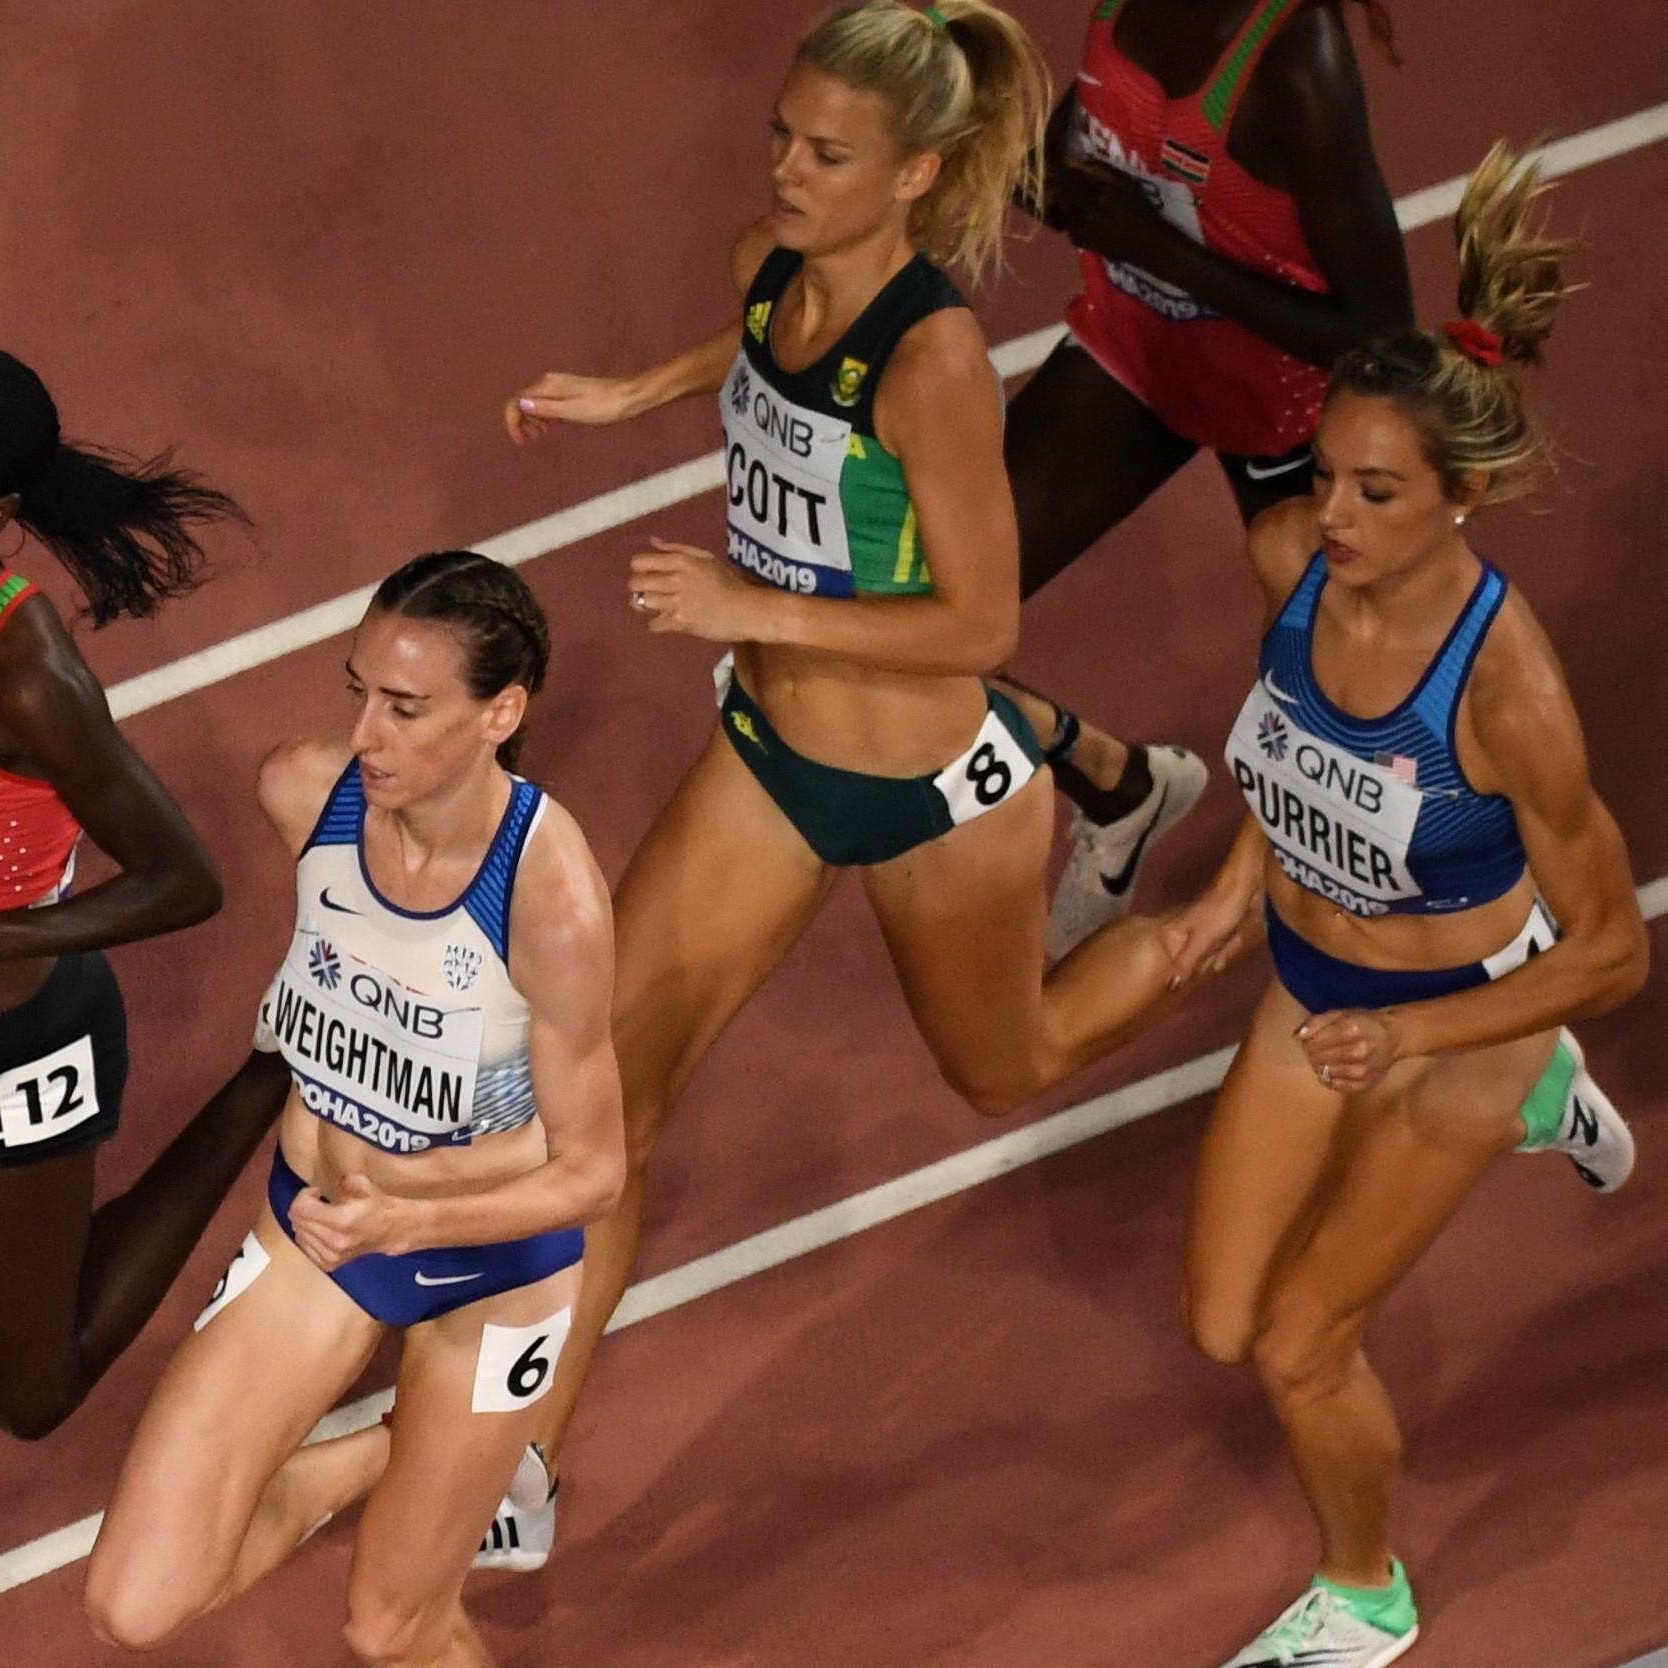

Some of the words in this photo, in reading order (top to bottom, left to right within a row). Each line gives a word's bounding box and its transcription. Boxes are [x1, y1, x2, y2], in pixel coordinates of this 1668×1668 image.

[754, 392, 814, 458] QNB
[725, 430, 826, 546] COTT
[966, 742, 1012, 806] 8
[1295, 745, 1383, 814] QNB
[1234, 757, 1401, 891] PURRIER
[350, 973, 444, 1040] QNB
[275, 980, 463, 1123] WEIGHTMAN
[15, 1064, 84, 1126] 12
[507, 1334, 550, 1398] 6
